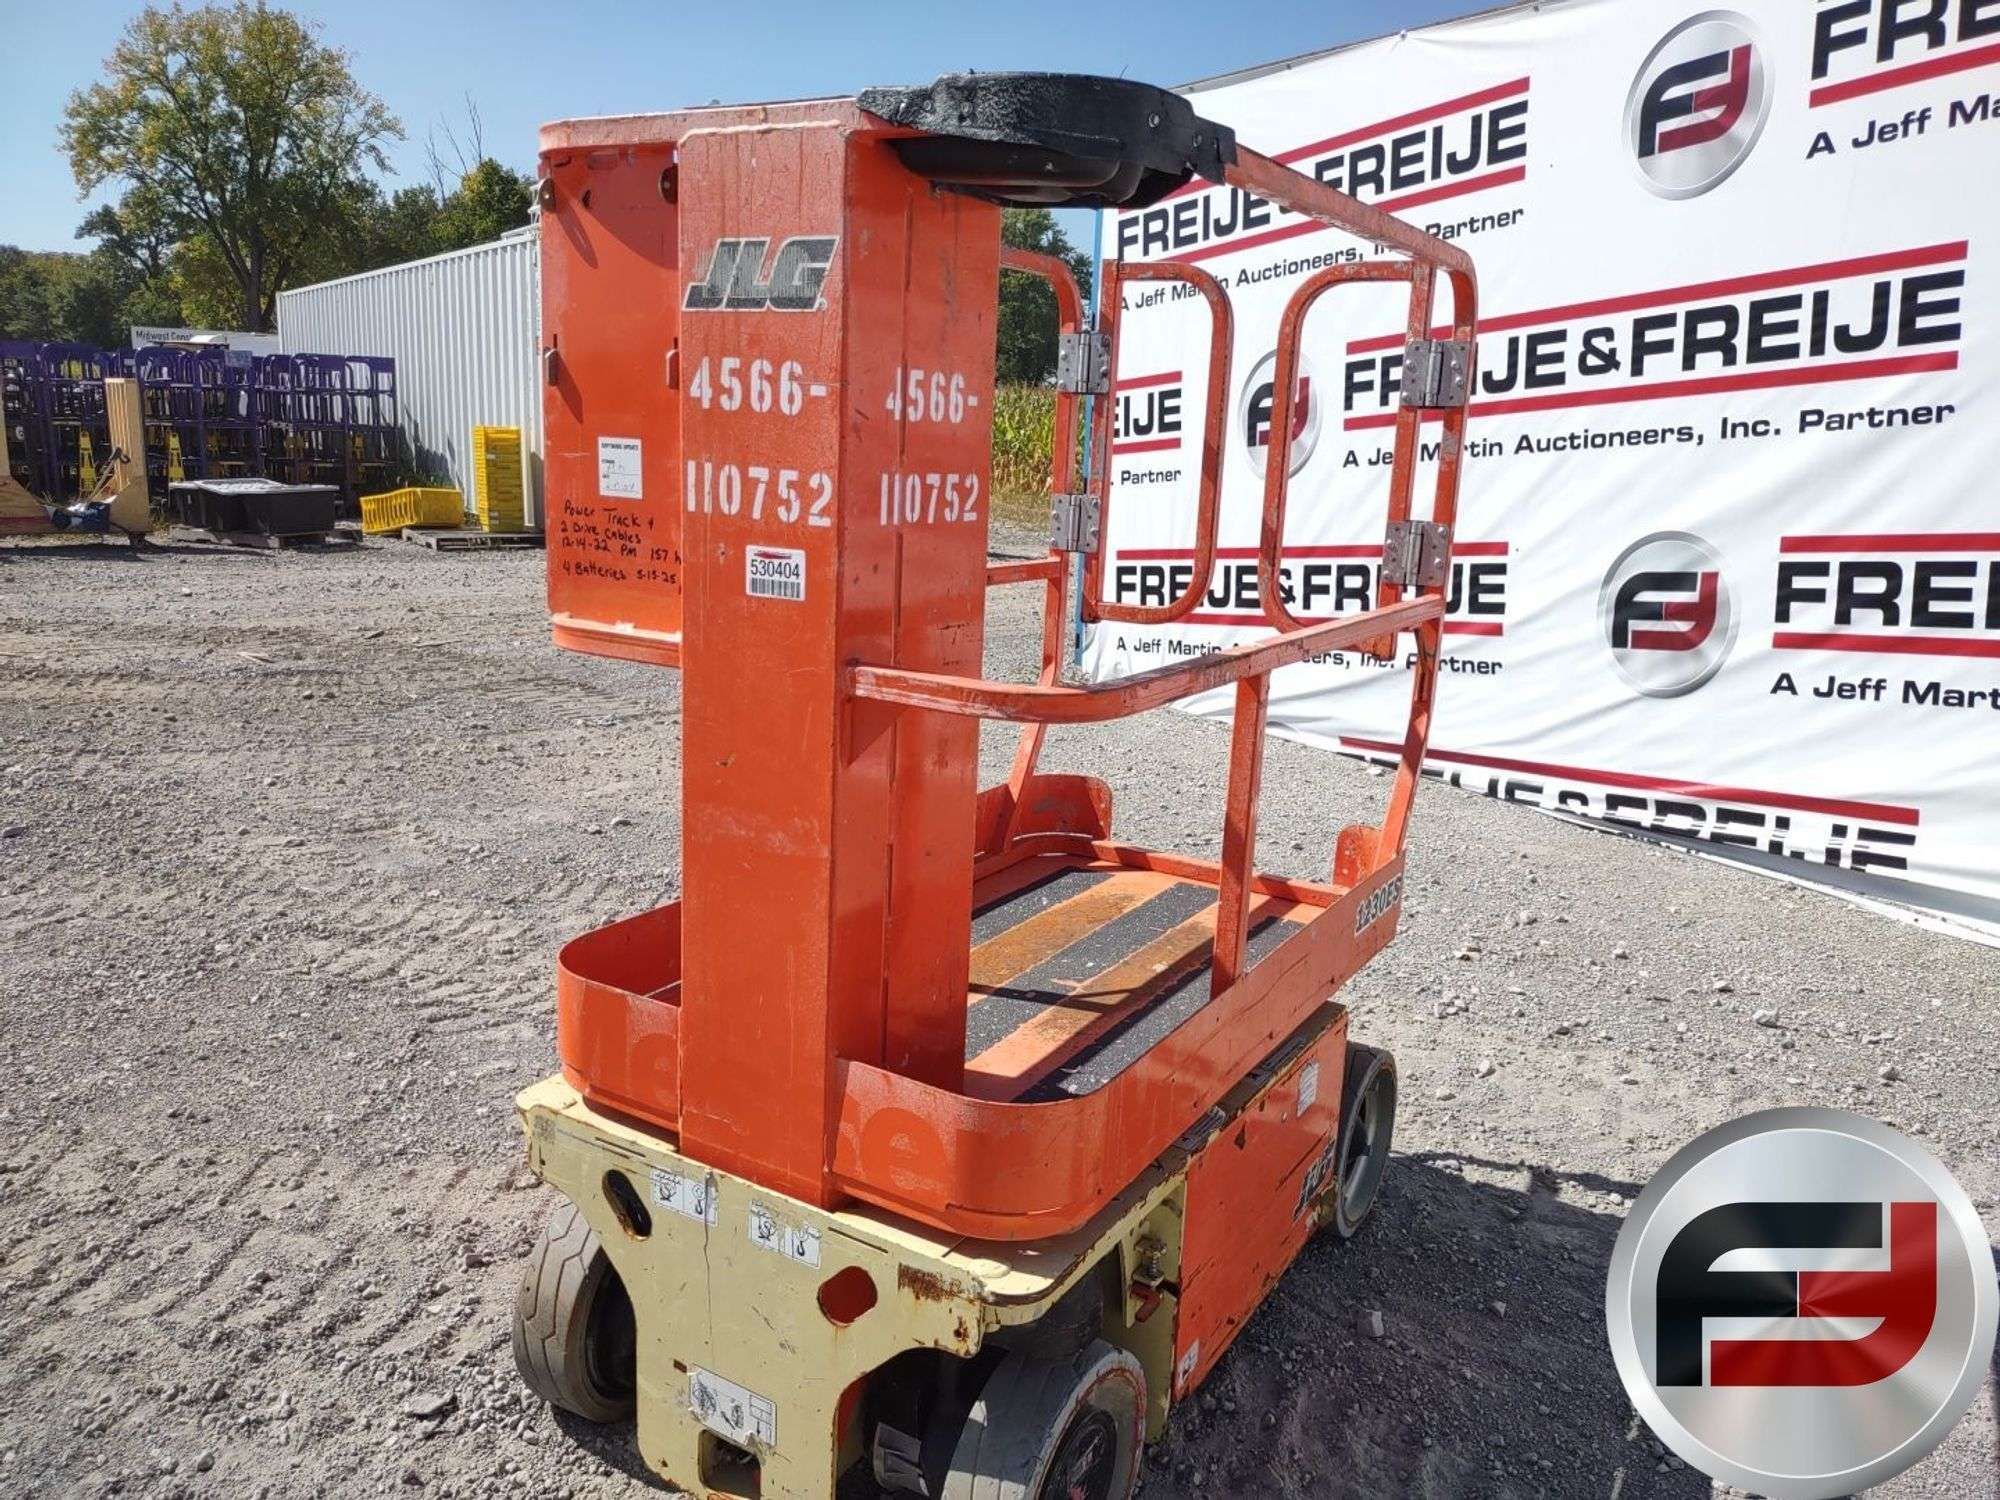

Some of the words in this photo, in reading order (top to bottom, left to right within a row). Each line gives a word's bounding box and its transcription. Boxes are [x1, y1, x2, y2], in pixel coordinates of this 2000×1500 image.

[1805, 131, 1837, 160] A
[1851, 107, 1932, 149] Jeff
[682, 236, 840, 312] JLG
[1135, 288, 1166, 309] Jeff
[1235, 247, 1364, 287] Auctioneers,
[690, 356, 828, 417] 4566-
[885, 366, 978, 424] 4566-
[1343, 450, 1360, 468] A
[1368, 448, 1394, 466] Je
[1420, 438, 1504, 462] Mtin
[1514, 425, 1705, 456] Auctioneers,
[1719, 416, 1782, 439] Inc.
[1798, 403, 1956, 434] Partner
[686, 460, 834, 527] 110752
[880, 473, 979, 527] 110752
[1120, 469, 1182, 486] Partner
[561, 520, 568, 533] 2
[604, 527, 641, 544] Cables
[564, 499, 596, 517] Power
[601, 508, 641, 528] Track
[562, 559, 571, 576] 4
[575, 561, 627, 581] Batteries
[620, 543, 637, 558] PM
[750, 559, 800, 579] 530404
[1116, 636, 1127, 651] A
[1133, 637, 1162, 654] Jeff
[1168, 639, 1223, 657] Martin
[1406, 655, 1504, 675] Prtner
[1769, 672, 1799, 696] A
[1812, 675, 1888, 702] Jeff
[1902, 680, 2000, 711] Mart
